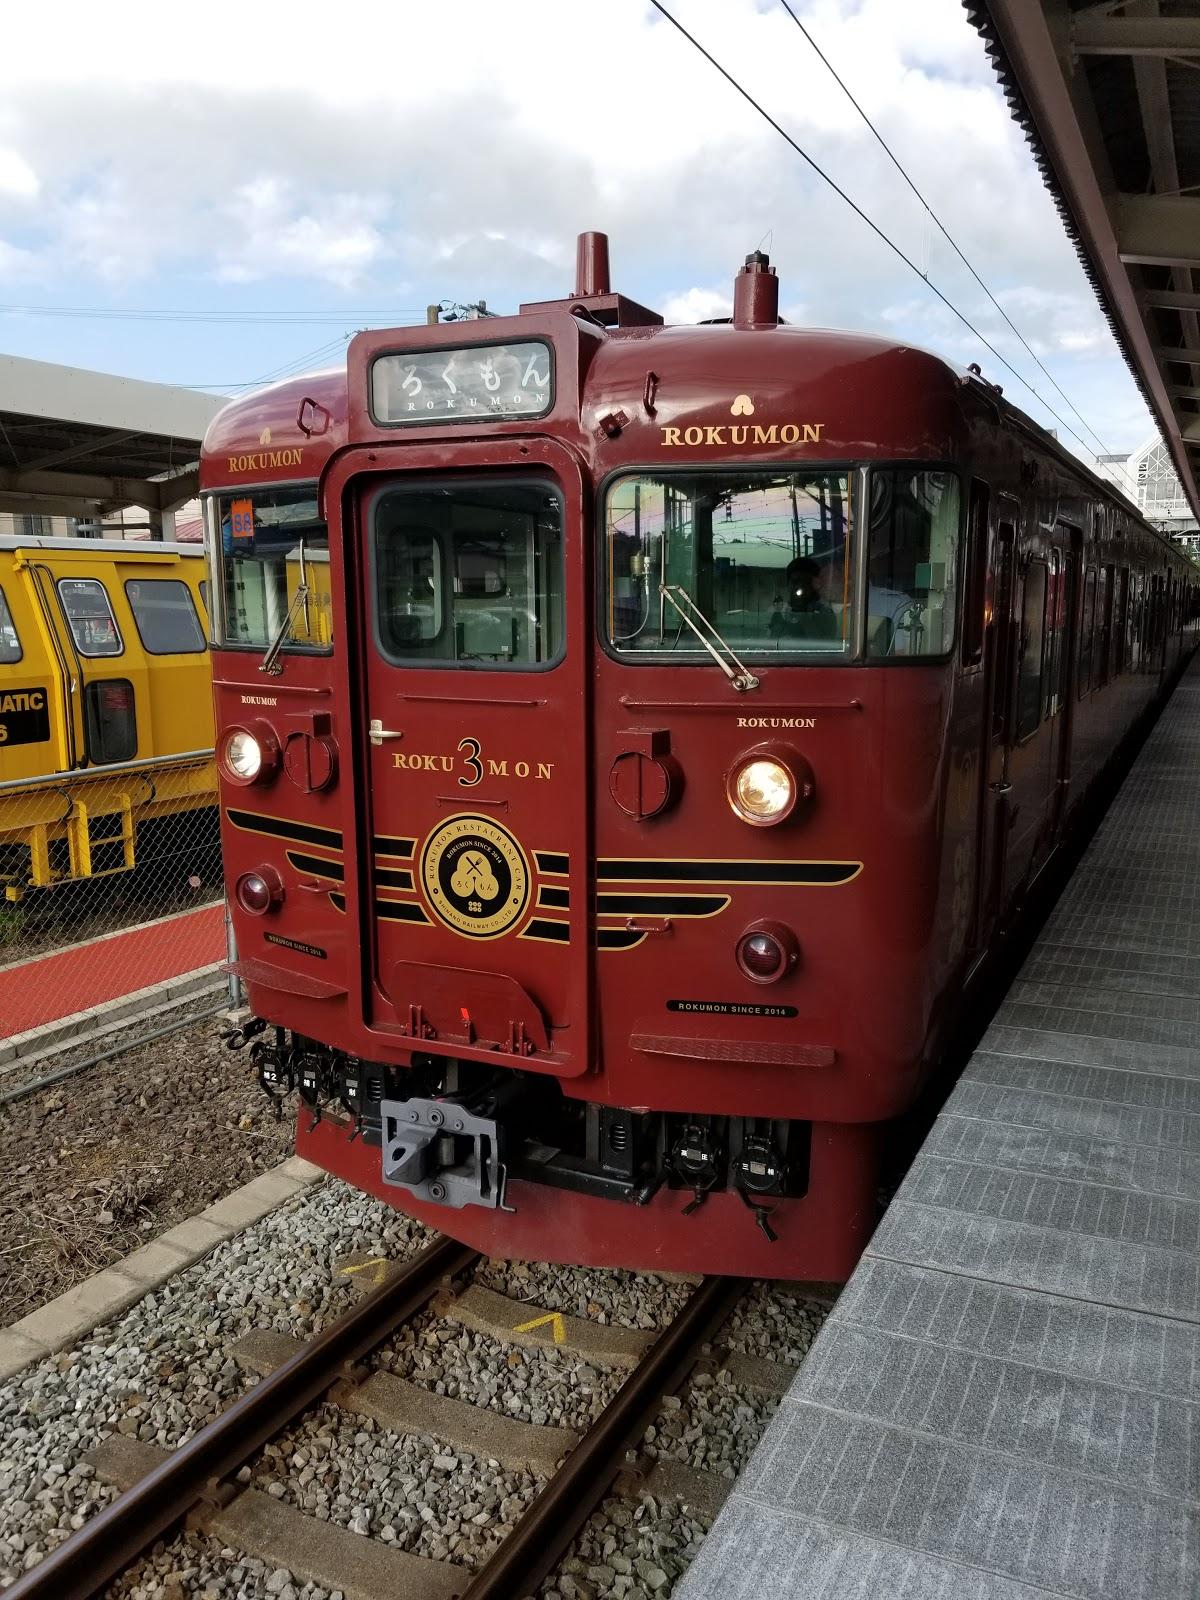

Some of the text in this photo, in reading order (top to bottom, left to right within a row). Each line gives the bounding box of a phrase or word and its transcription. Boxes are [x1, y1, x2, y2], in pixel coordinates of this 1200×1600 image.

[402, 352, 549, 397] ろくもん
[407, 393, 545, 411] ROKUMON
[661, 424, 825, 446] ROKUMON
[228, 448, 304, 473] ROKUMON
[0, 692, 44, 713] ATIC
[241, 695, 278, 706] ROKUMON
[736, 717, 817, 728] ROKUMON
[391, 737, 555, 787] ROKU 3 MON
[429, 831, 453, 880] ROKUMON
[456, 824, 518, 862] RESTAURANT
[678, 1003, 728, 1012] ROKUMON
[731, 1006, 761, 1014] SINCE
